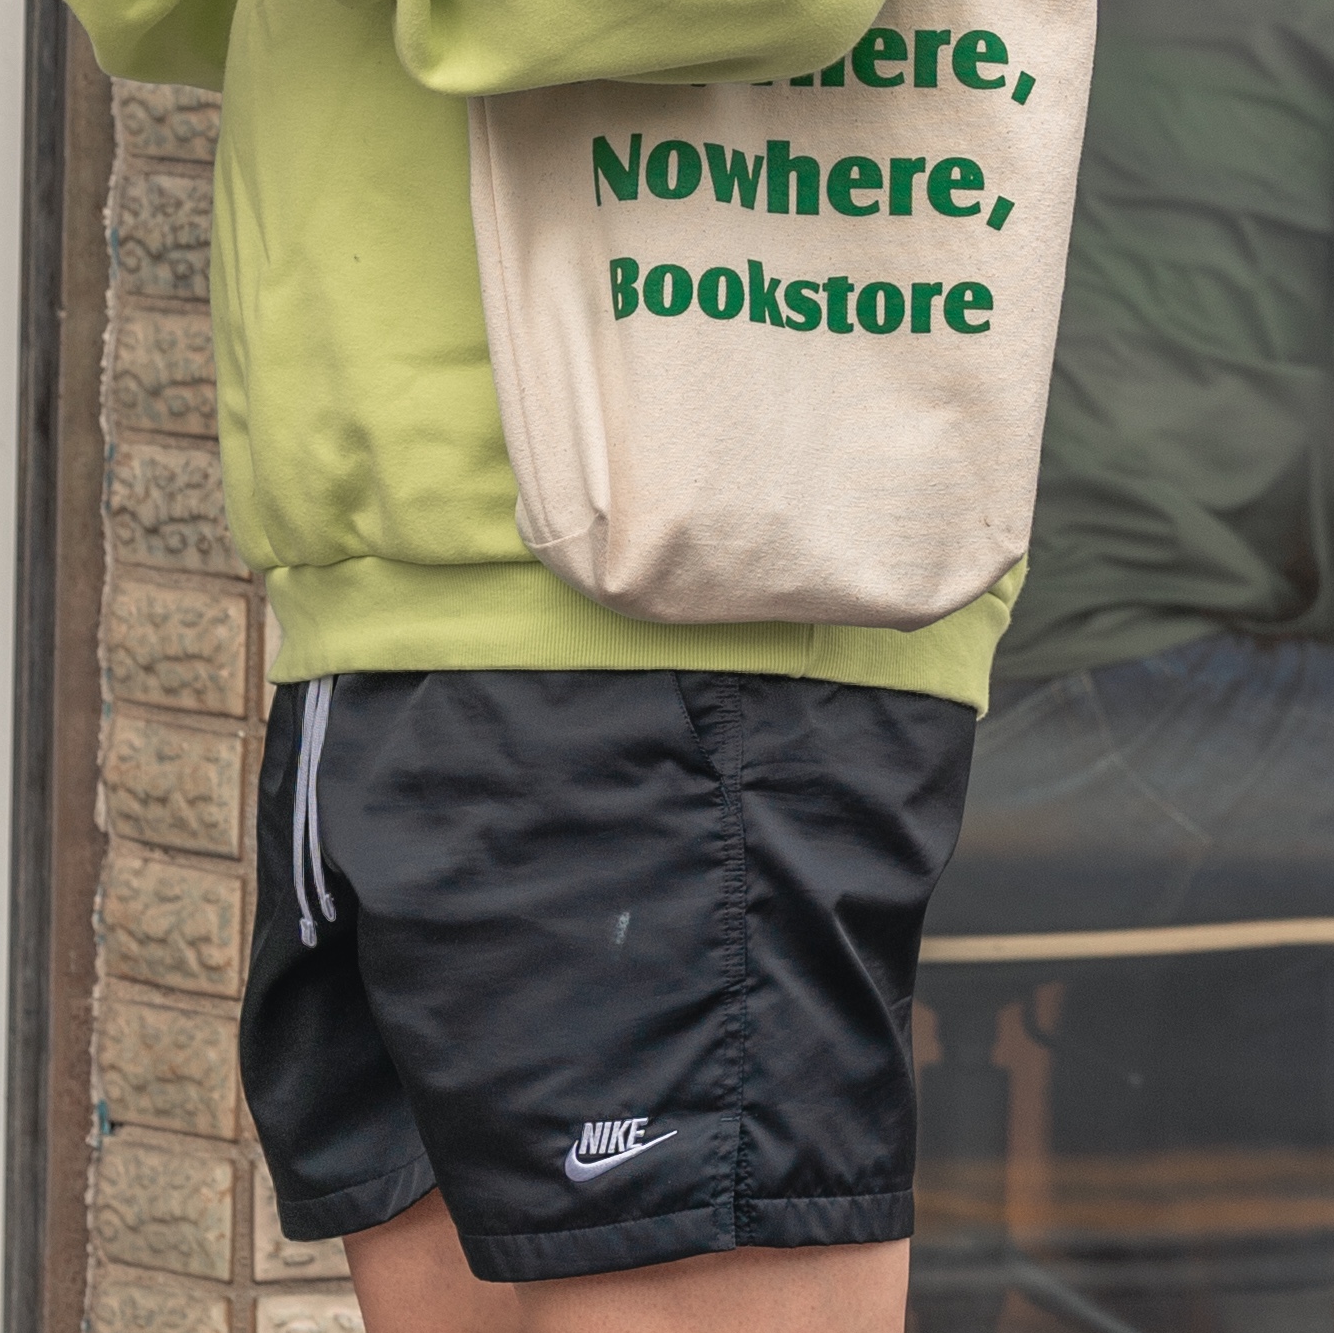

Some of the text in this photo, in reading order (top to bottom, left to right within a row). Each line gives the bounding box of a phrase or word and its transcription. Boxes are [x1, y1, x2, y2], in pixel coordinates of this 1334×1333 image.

[591, 133, 1016, 232] Nowhere,
[609, 257, 995, 335] Bookstore
[578, 1117, 649, 1155] NIKE
